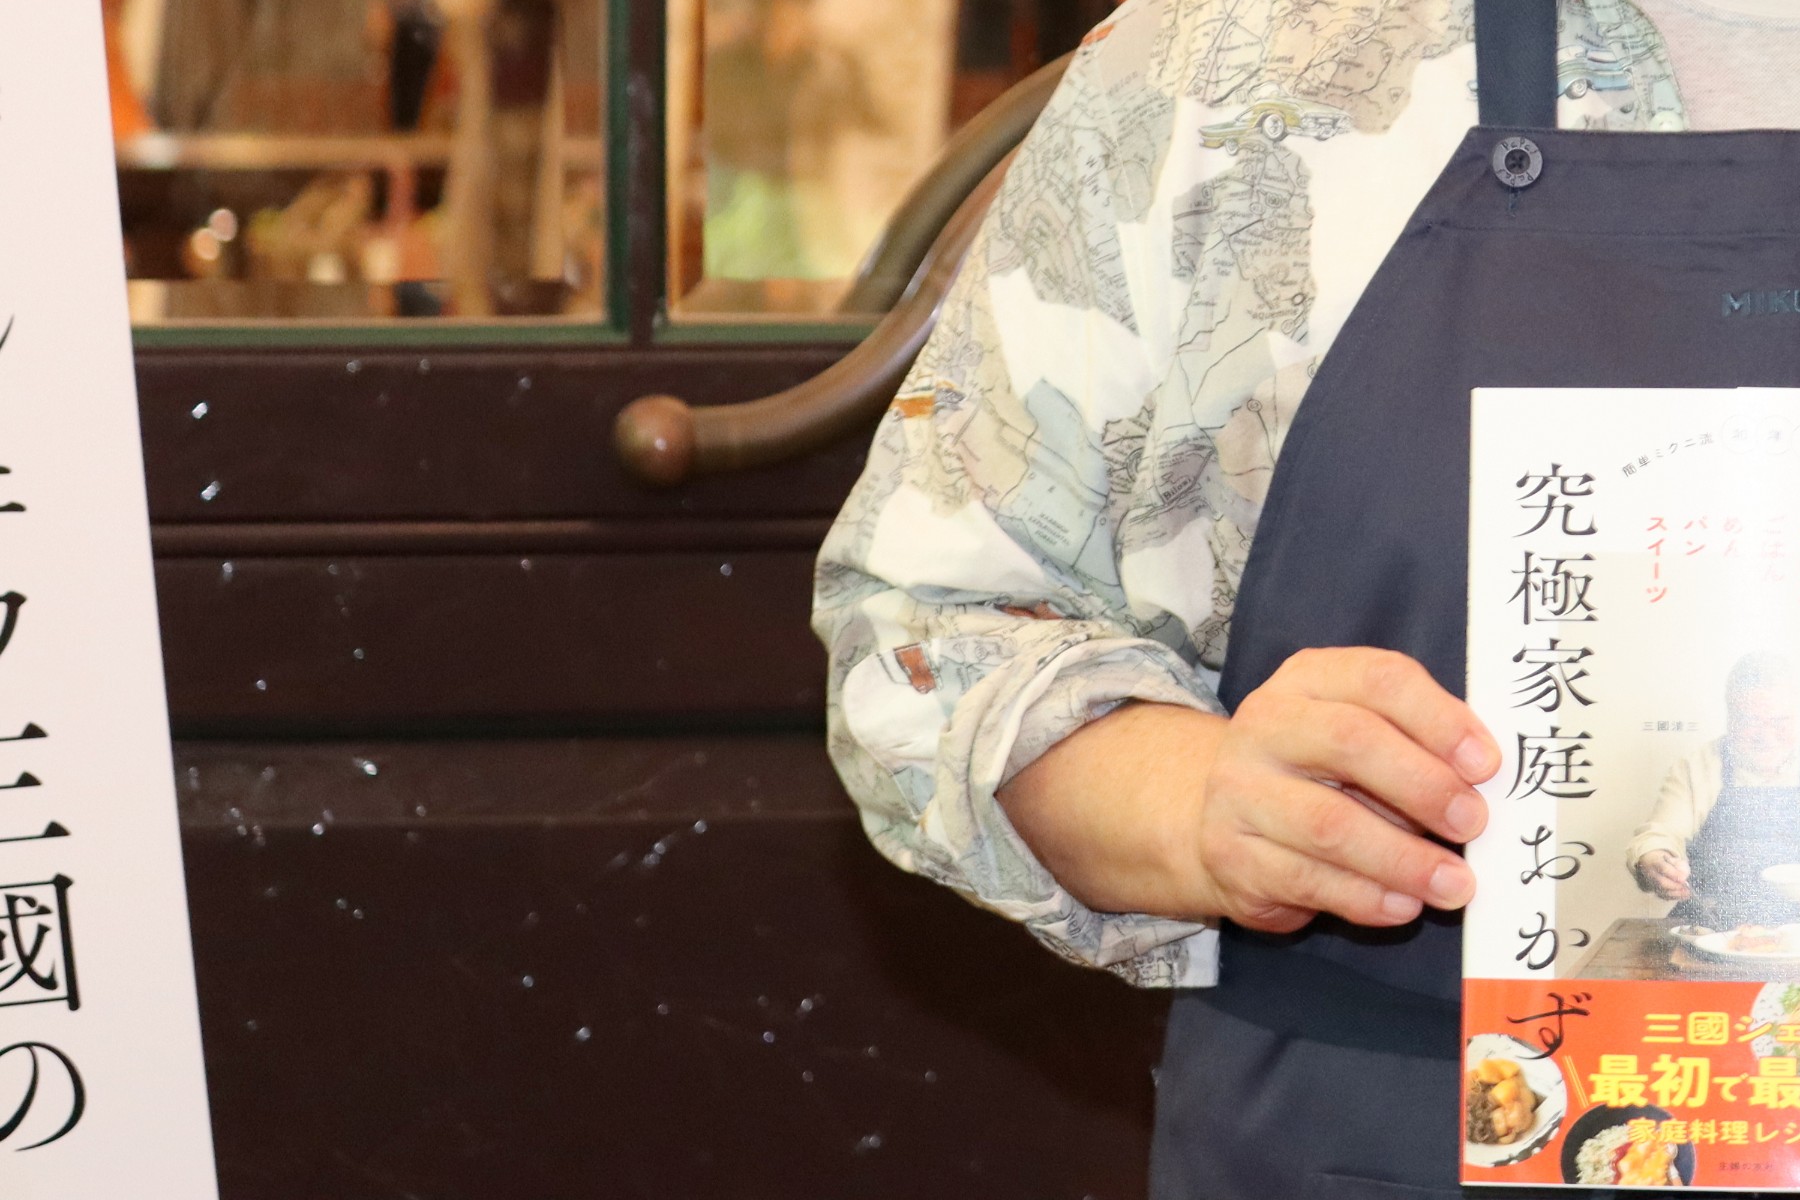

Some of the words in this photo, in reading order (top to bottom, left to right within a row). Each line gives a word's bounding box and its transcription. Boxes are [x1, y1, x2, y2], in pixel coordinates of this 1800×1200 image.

[1645, 516, 1669, 604] スイーツ
[1683, 514, 1709, 557] パン
[1505, 461, 1599, 1061] 究極家庭おかず
